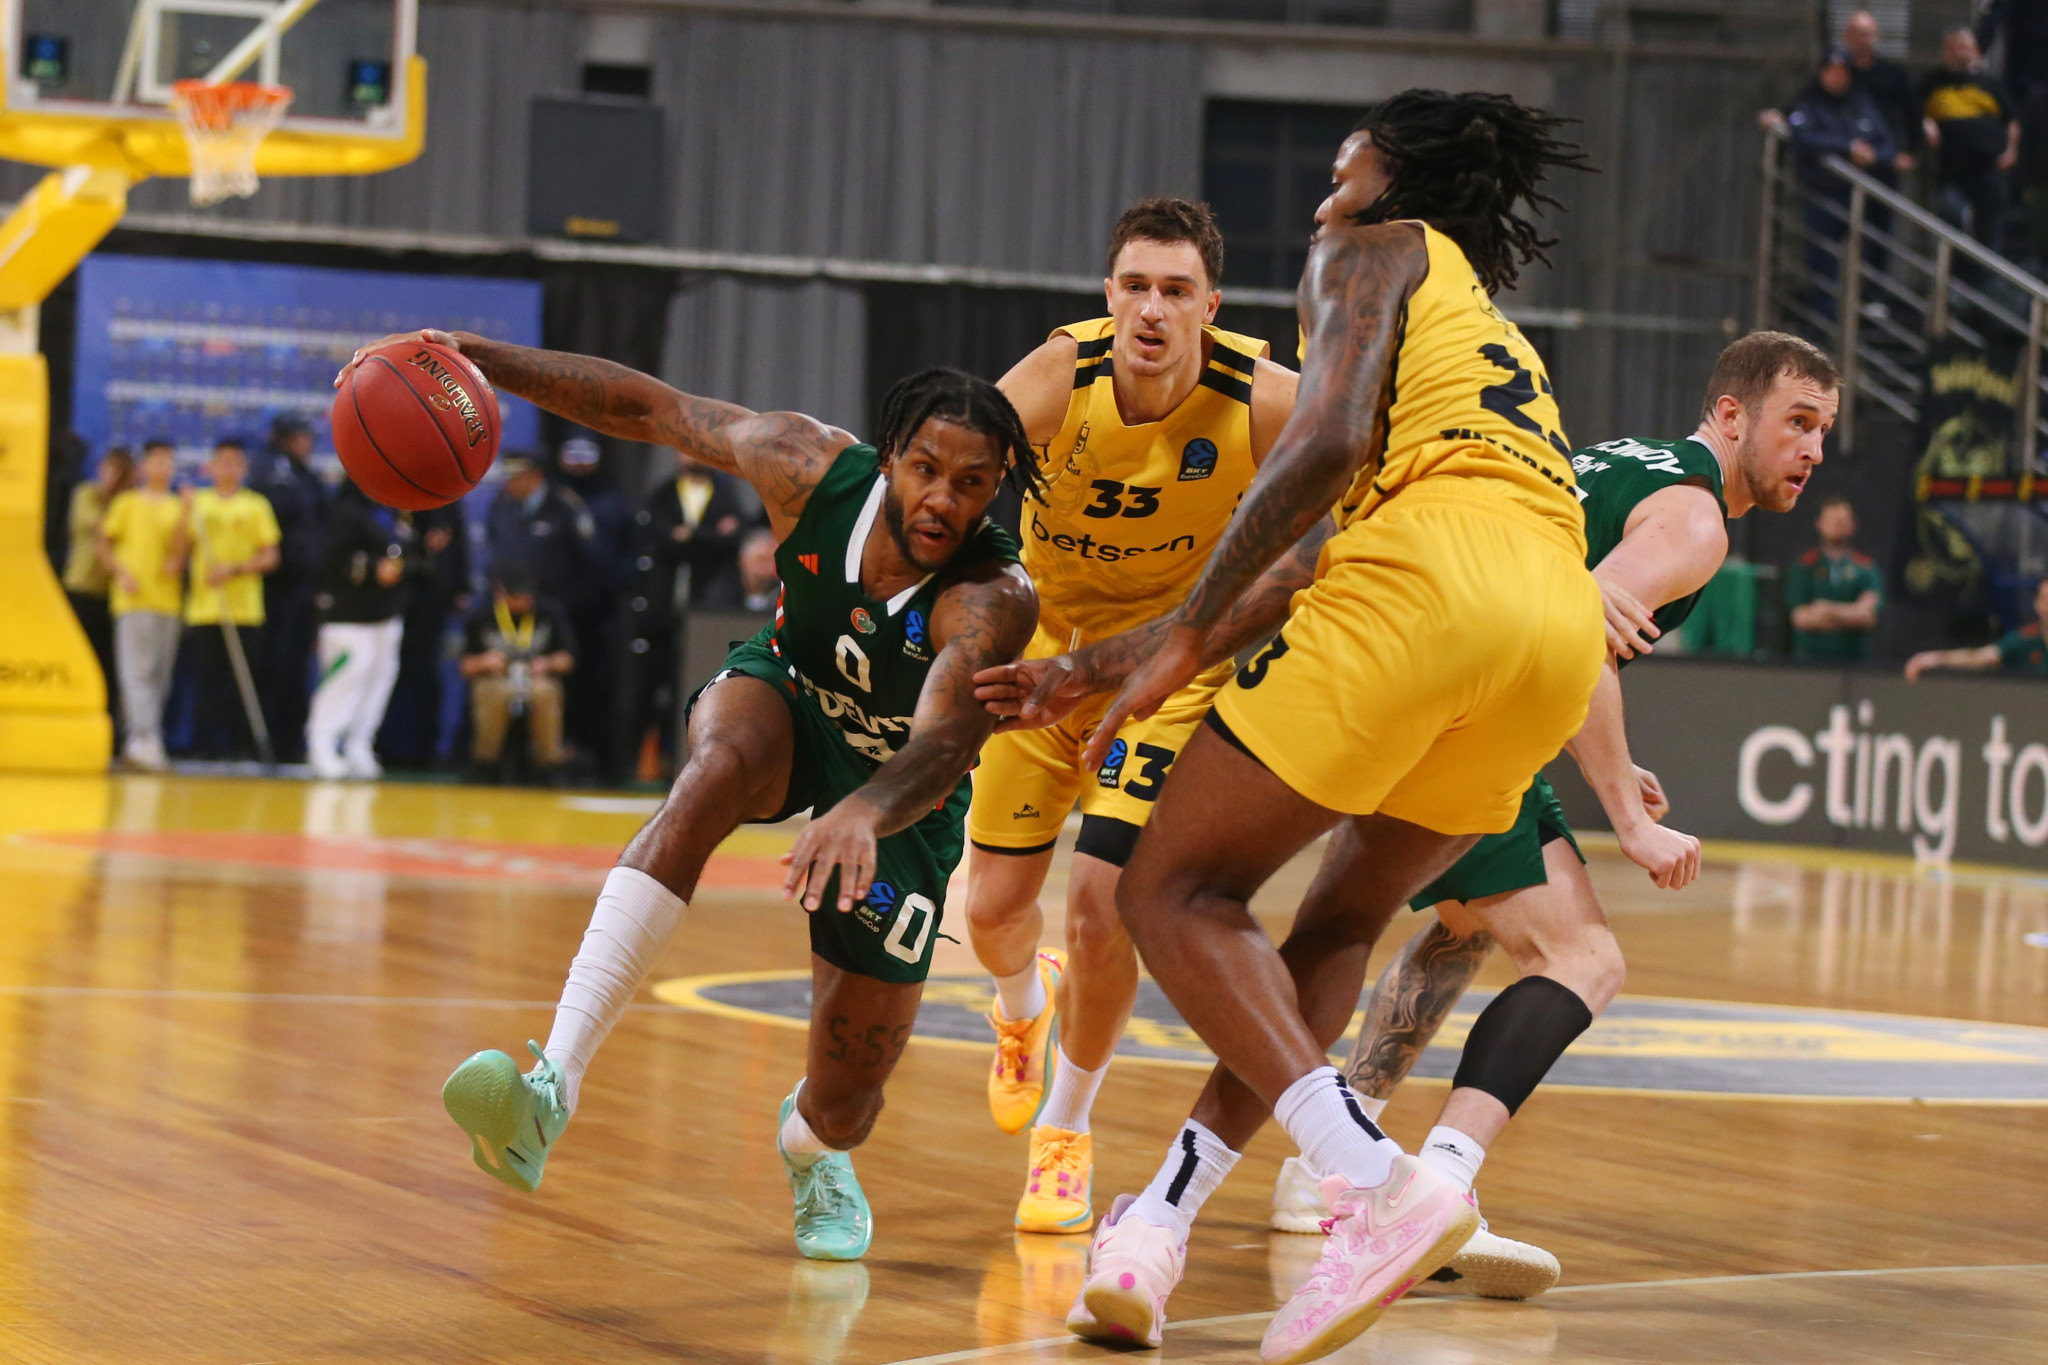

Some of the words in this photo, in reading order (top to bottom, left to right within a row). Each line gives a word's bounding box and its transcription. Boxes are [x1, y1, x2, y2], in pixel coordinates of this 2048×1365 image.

[407, 350, 488, 449] SPALDING
[1082, 479, 1163, 519] 33
[1737, 699, 1961, 862] cting
[1982, 714, 2048, 846] to
[884, 892, 937, 965] 0
